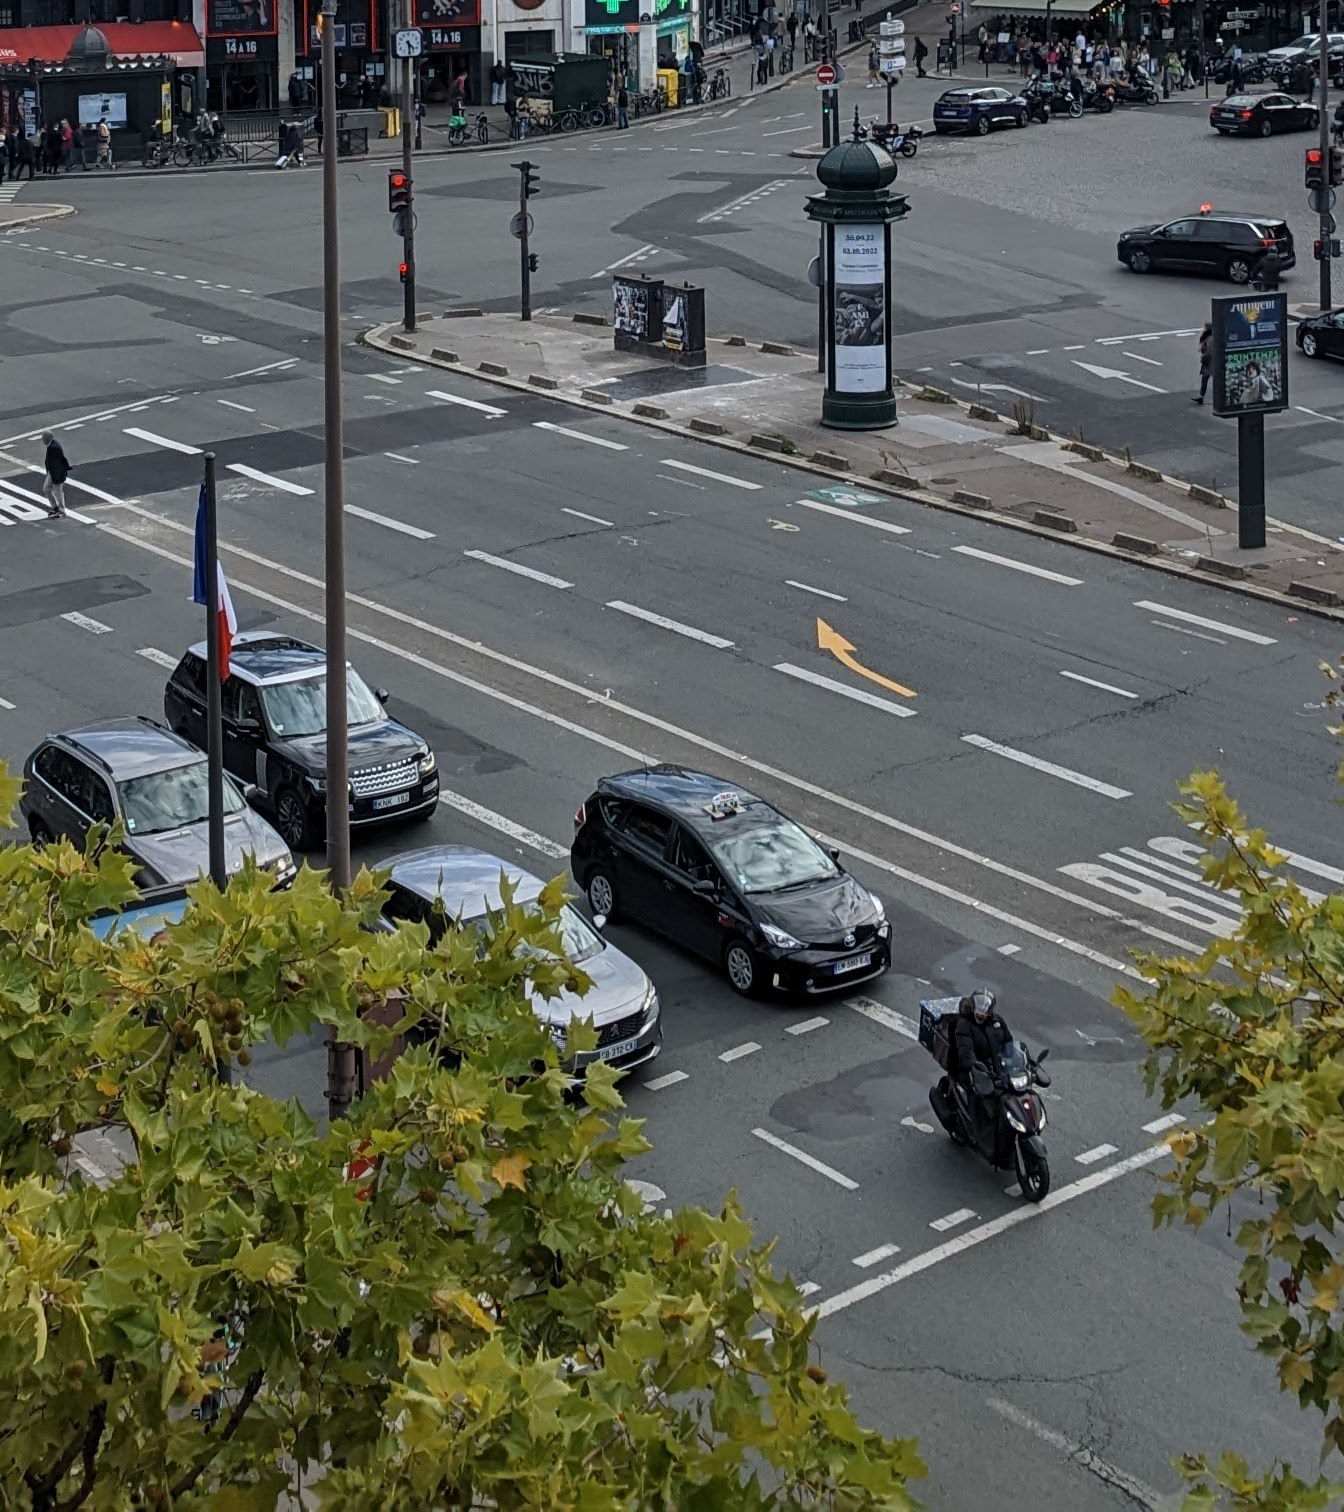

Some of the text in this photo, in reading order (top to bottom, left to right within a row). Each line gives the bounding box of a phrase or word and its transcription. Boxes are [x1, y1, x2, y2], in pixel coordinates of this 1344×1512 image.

[431, 31, 442, 43] 14
[451, 31, 461, 43] 16
[226, 41, 236, 54] 14
[246, 41, 257, 53] 16
[1227, 349, 1279, 363] PRINTEMPS
